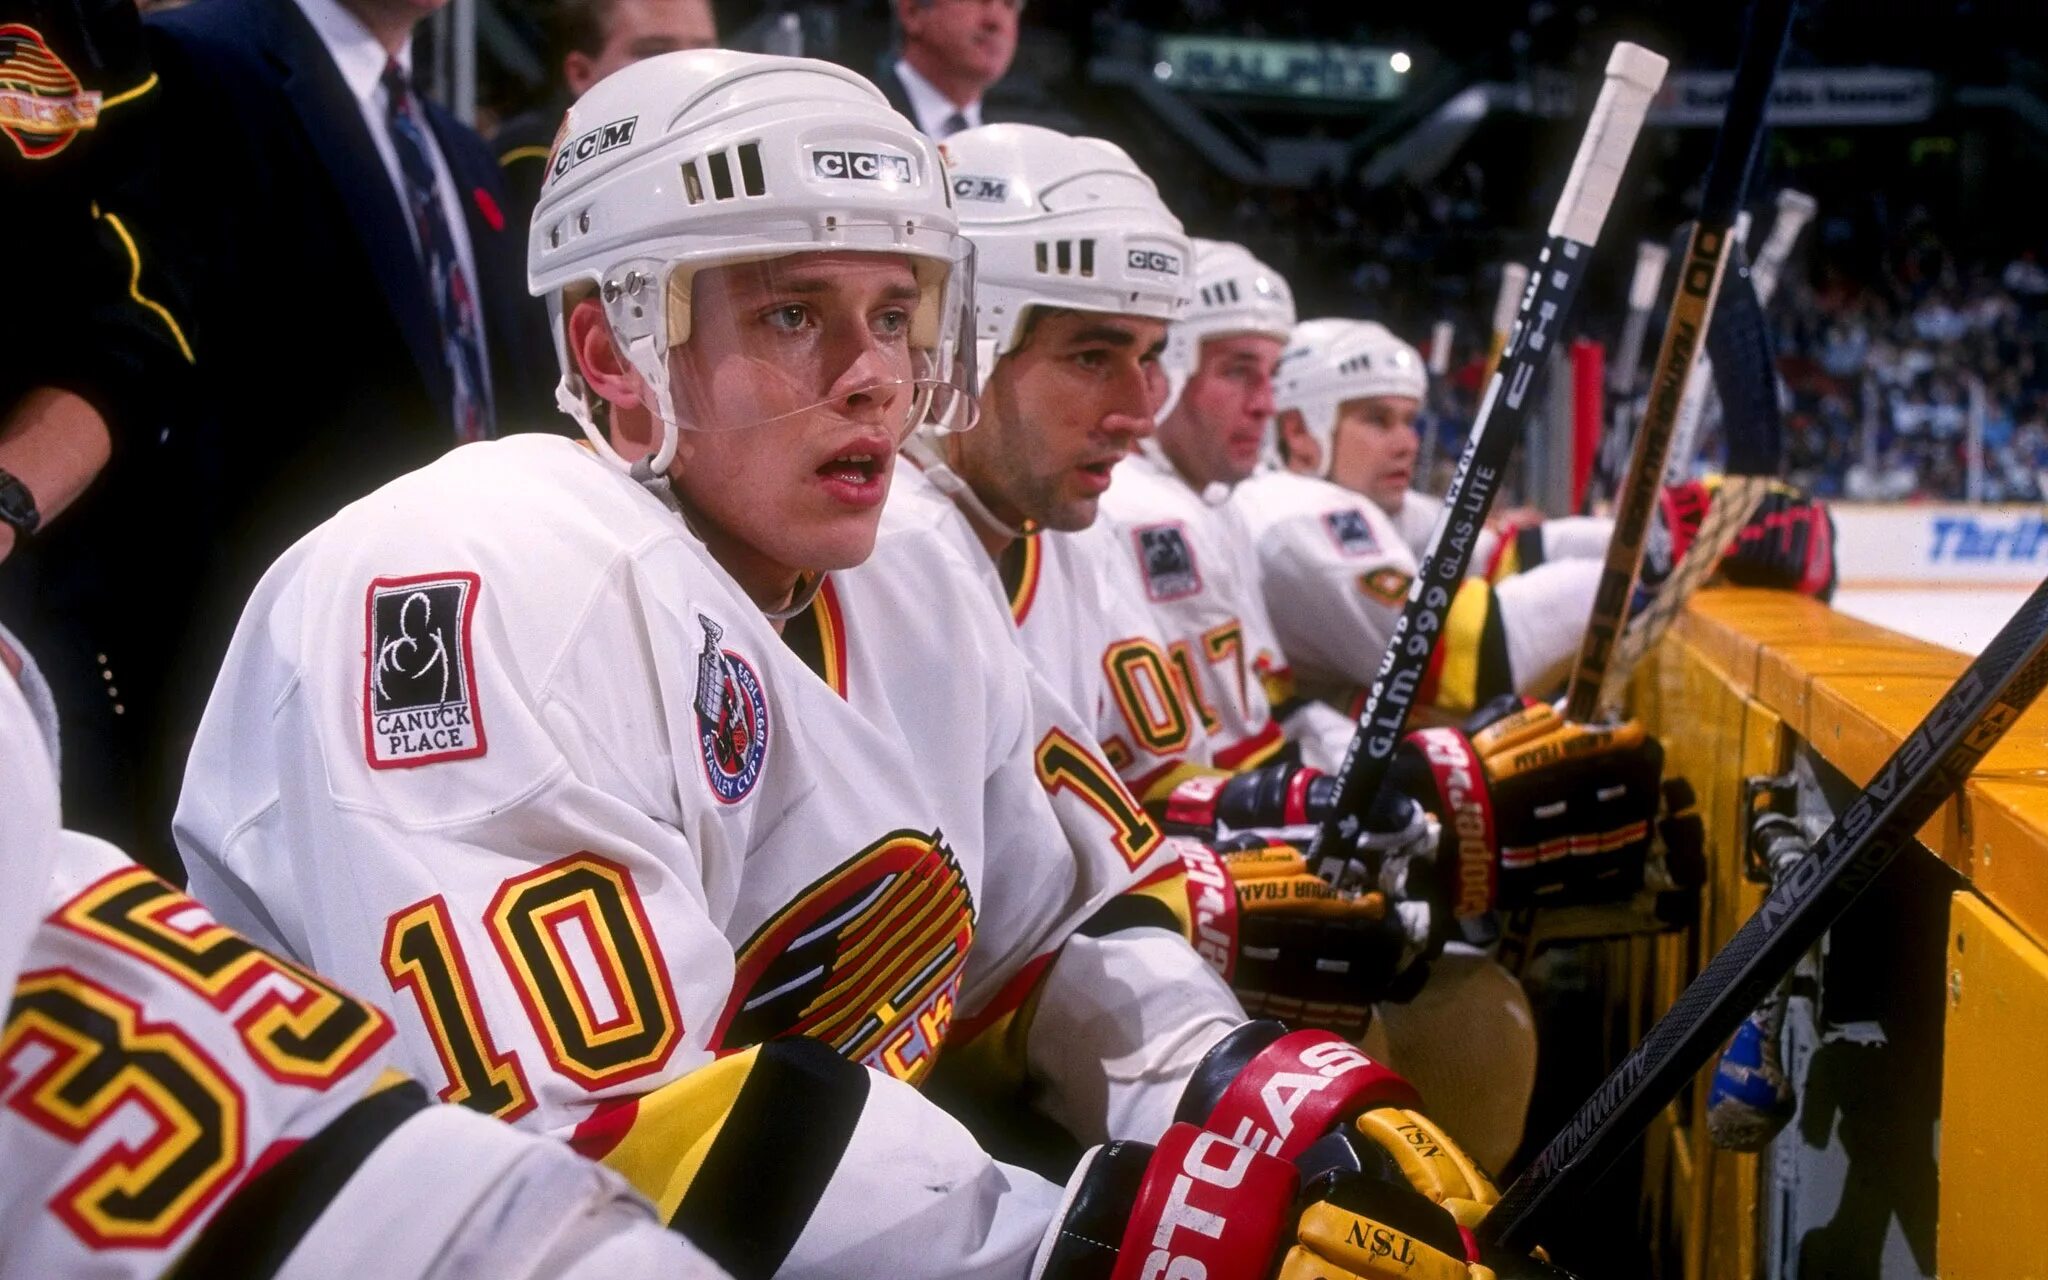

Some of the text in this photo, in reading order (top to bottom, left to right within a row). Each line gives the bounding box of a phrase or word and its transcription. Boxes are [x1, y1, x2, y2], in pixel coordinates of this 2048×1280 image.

[554, 117, 635, 179] CCM
[814, 152, 911, 183] CCM
[953, 177, 1006, 202] CM
[1129, 251, 1180, 275] CCM
[1438, 464, 1497, 580] GLAS-LITE
[376, 705, 471, 736] CANUCK
[388, 727, 464, 756] PLACE
[701, 733, 757, 799] STANLEY CUP
[1757, 730, 1930, 934] EASTON
[380, 849, 686, 1124] 10
[0, 864, 397, 1252] 35
[1545, 1042, 1649, 1178] ALUMINUM
[1344, 1219, 1417, 1271] TSN
